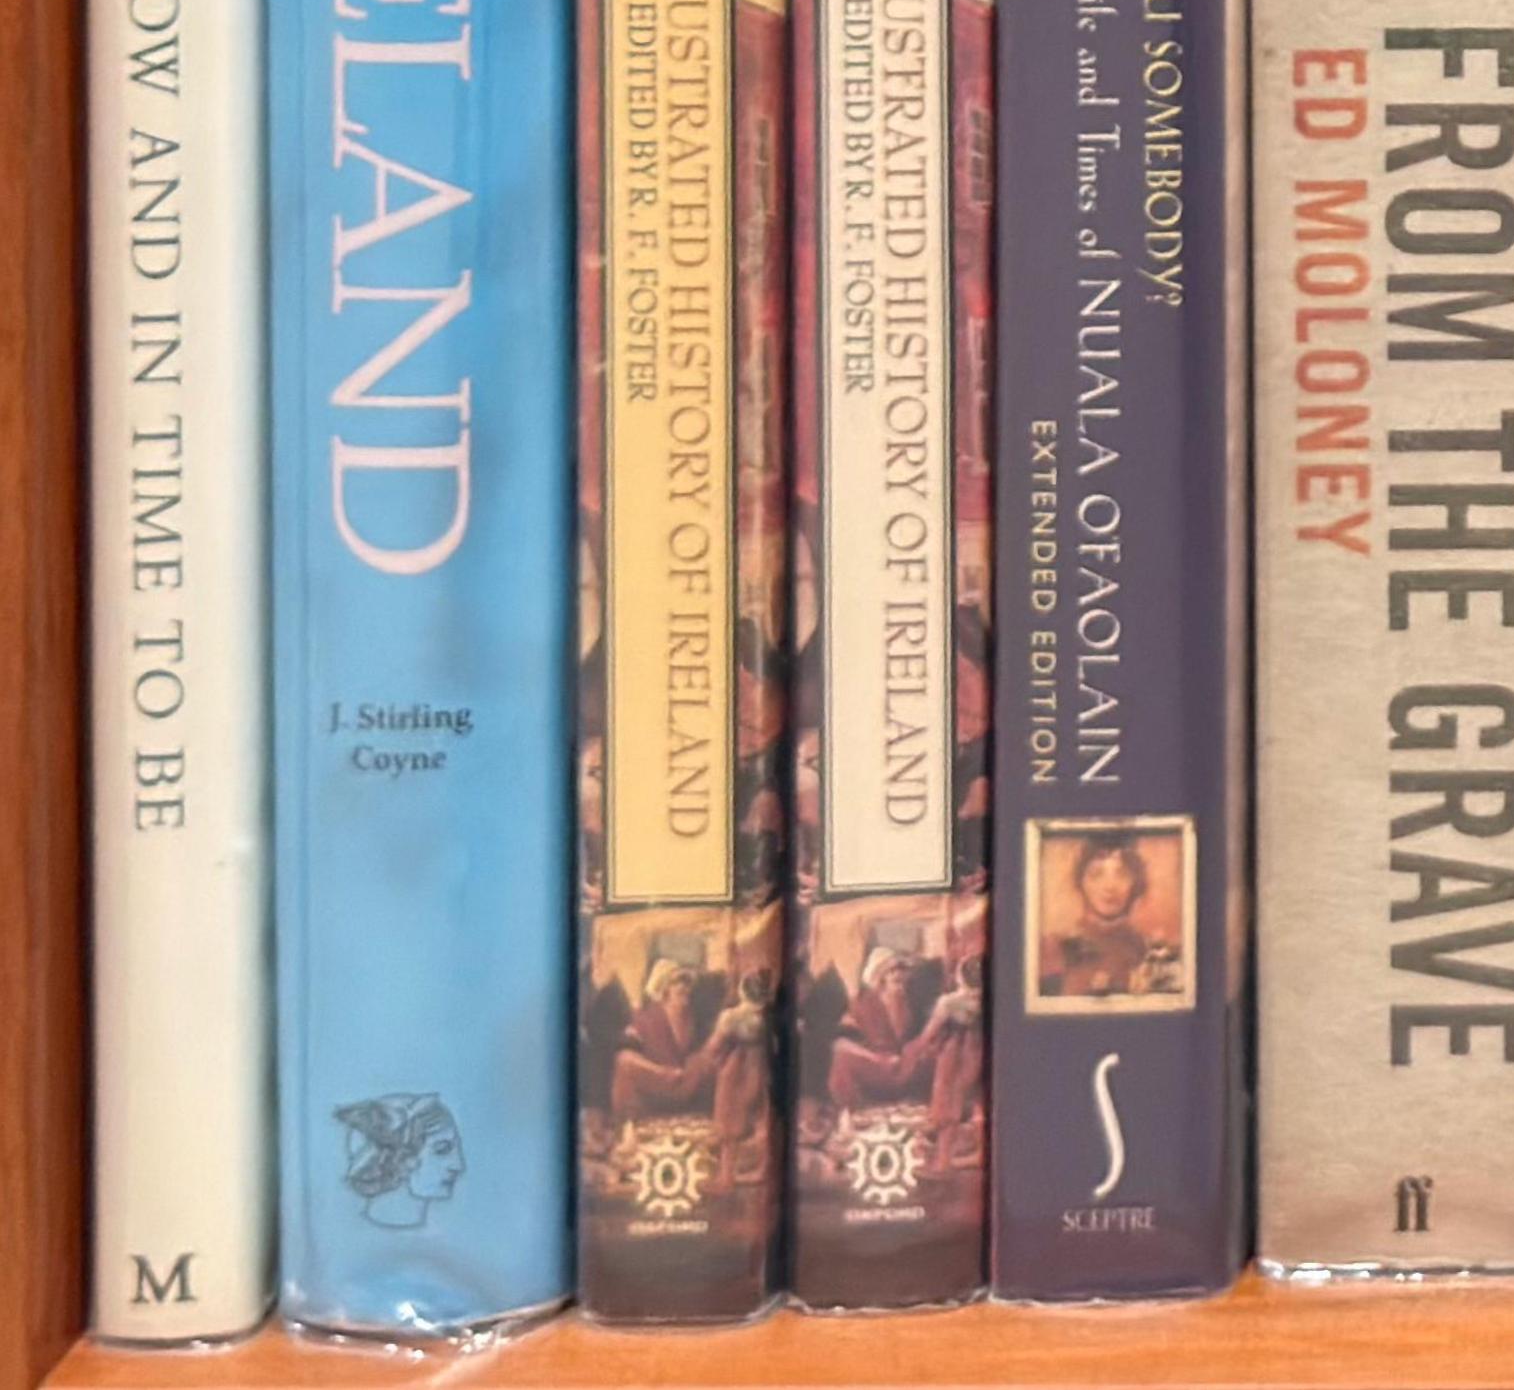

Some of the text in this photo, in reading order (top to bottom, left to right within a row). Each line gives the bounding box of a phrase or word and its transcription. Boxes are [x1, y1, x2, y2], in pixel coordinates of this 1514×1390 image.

[1077, 46, 1121, 107] and
[844, 131, 875, 174] BY
[844, 179, 875, 212] R.
[1077, 121, 1122, 214] Times
[1142, 40, 1185, 308] SOMEBODY?
[130, 129, 182, 281] AND
[626, 2, 659, 403] EDITED BY R. F. FOSTER
[845, 221, 876, 251] F.
[1077, 227, 1121, 261] of
[843, 258, 876, 396] FOSTER
[1291, 48, 1371, 556] ED MOLONEY
[131, 312, 182, 386] IN
[883, 276, 929, 501] HISTORY
[1076, 279, 1121, 476] NUALA
[667, 285, 713, 511] HISTORY
[133, 413, 183, 592] TIME
[668, 522, 713, 599] OF
[885, 511, 929, 589] OF
[1031, 418, 1058, 786] EXTENDED EDITION
[134, 619, 184, 719] TO
[885, 599, 929, 828] IRELAND
[328, 701, 474, 735] J. Stirling
[351, 745, 447, 778] Coyne
[667, 611, 713, 840] IRELAND
[135, 747, 186, 831] BE
[1060, 1207, 1155, 1233] SCEPTRE
[131, 1253, 197, 1304] M
